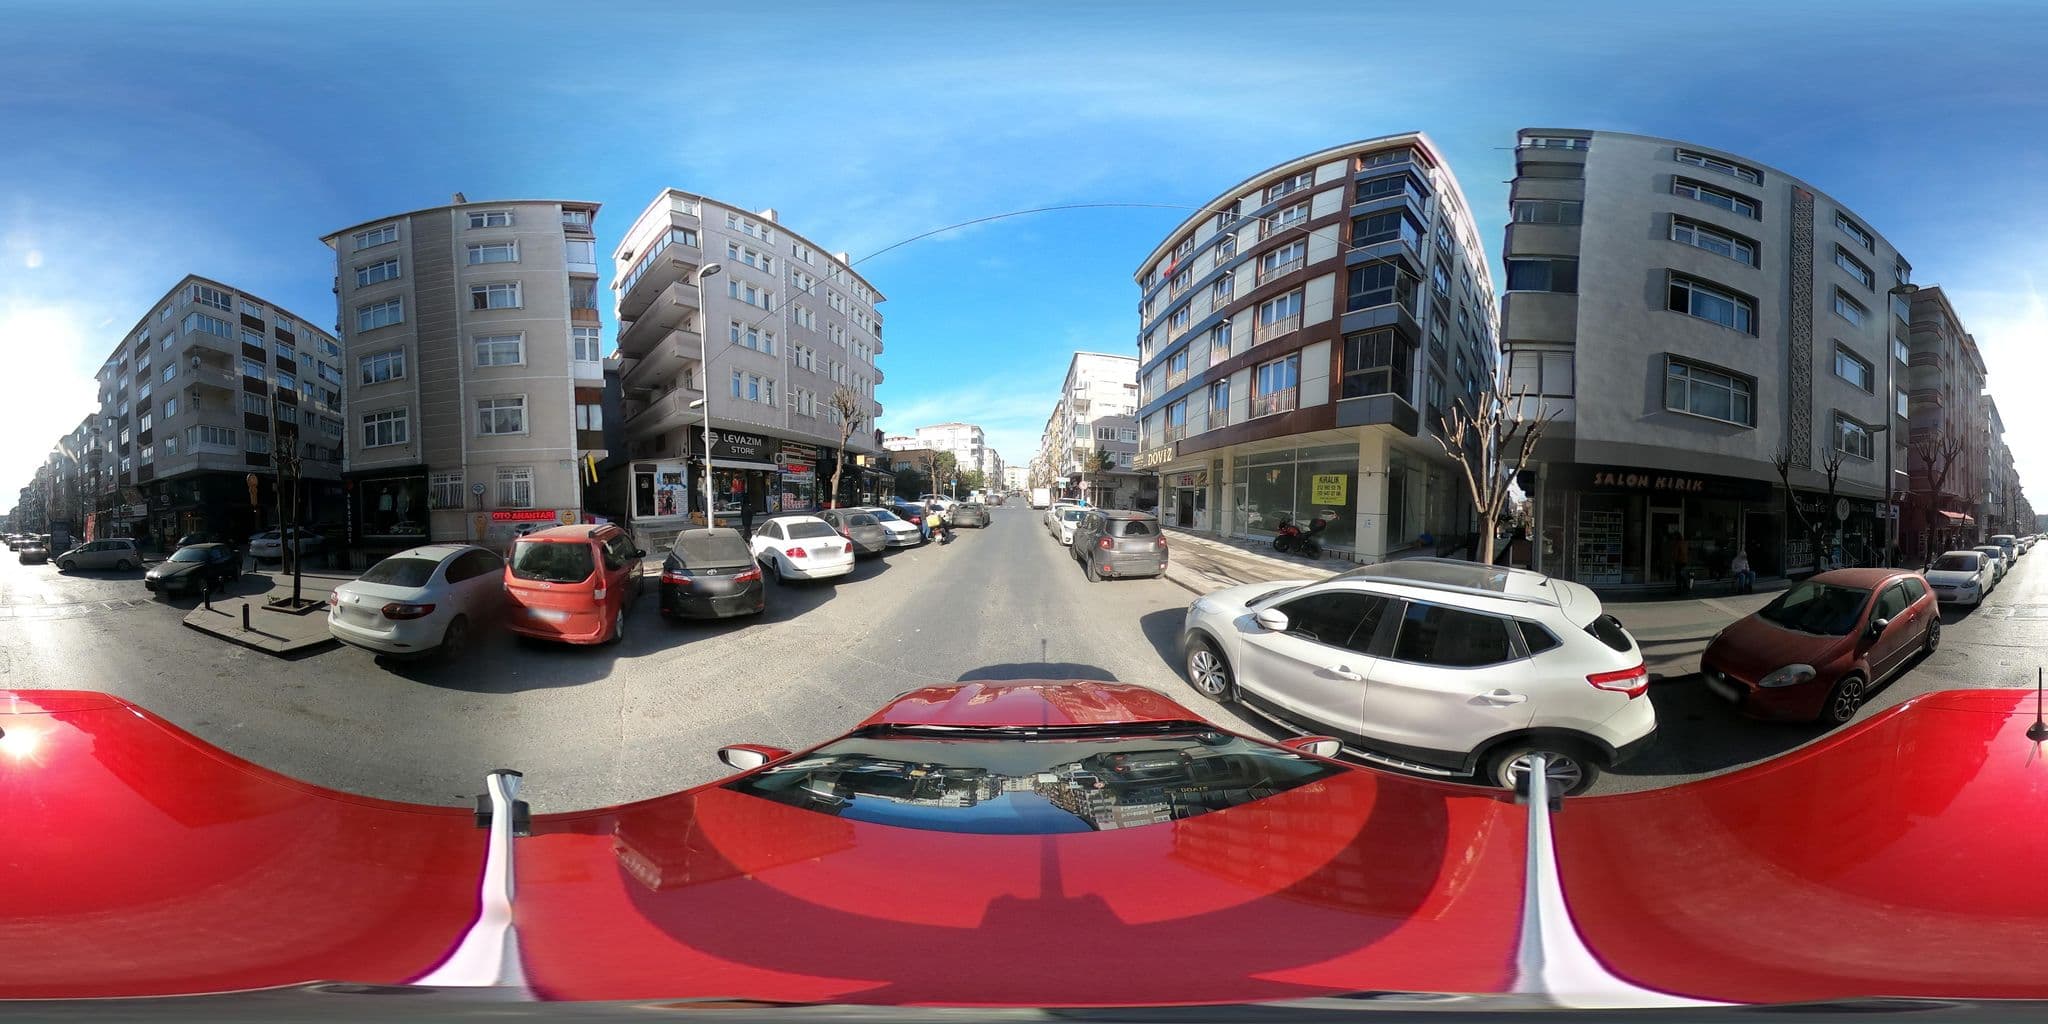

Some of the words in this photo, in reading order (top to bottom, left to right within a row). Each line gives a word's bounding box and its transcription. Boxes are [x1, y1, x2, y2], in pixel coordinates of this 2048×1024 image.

[723, 433, 762, 447] LEVAZIM
[731, 447, 754, 455] STORE
[1593, 472, 1649, 488] SALON
